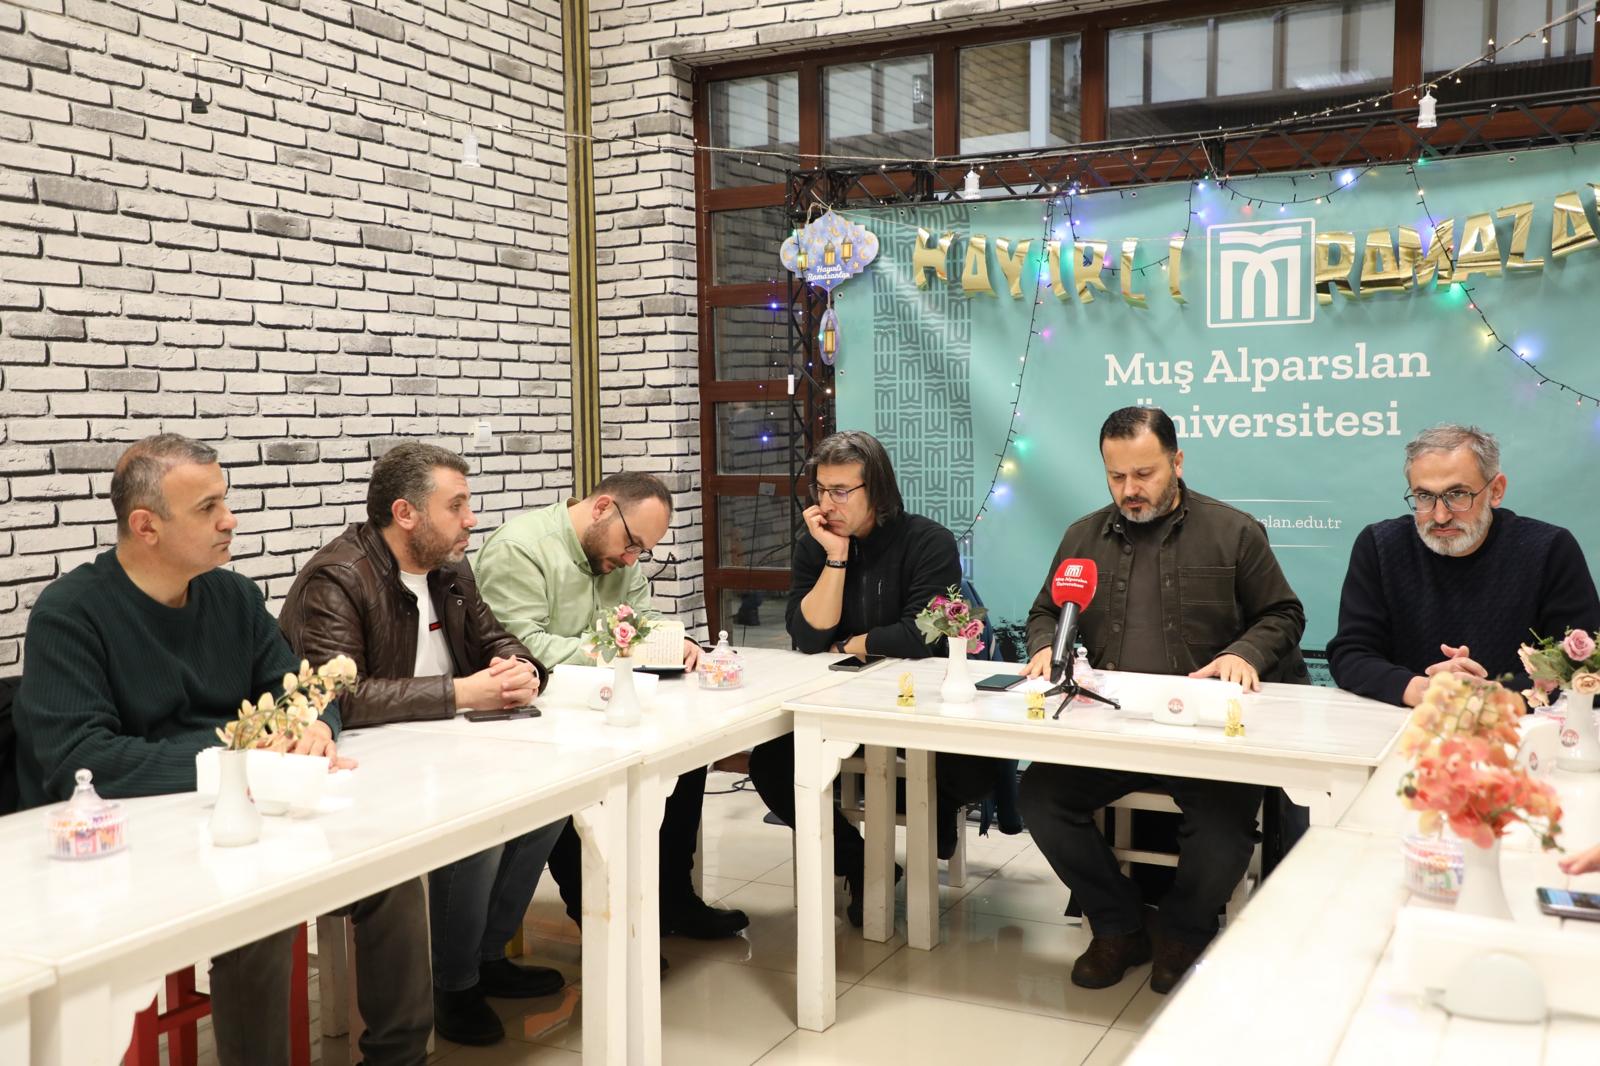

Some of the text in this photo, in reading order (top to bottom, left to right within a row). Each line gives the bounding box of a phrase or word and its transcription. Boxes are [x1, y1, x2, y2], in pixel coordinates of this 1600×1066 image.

[913, 227, 1188, 309] HAYIRLI
[1105, 342, 1431, 393] Muş Alparslan
[1137, 398, 1401, 438] niversitesi
